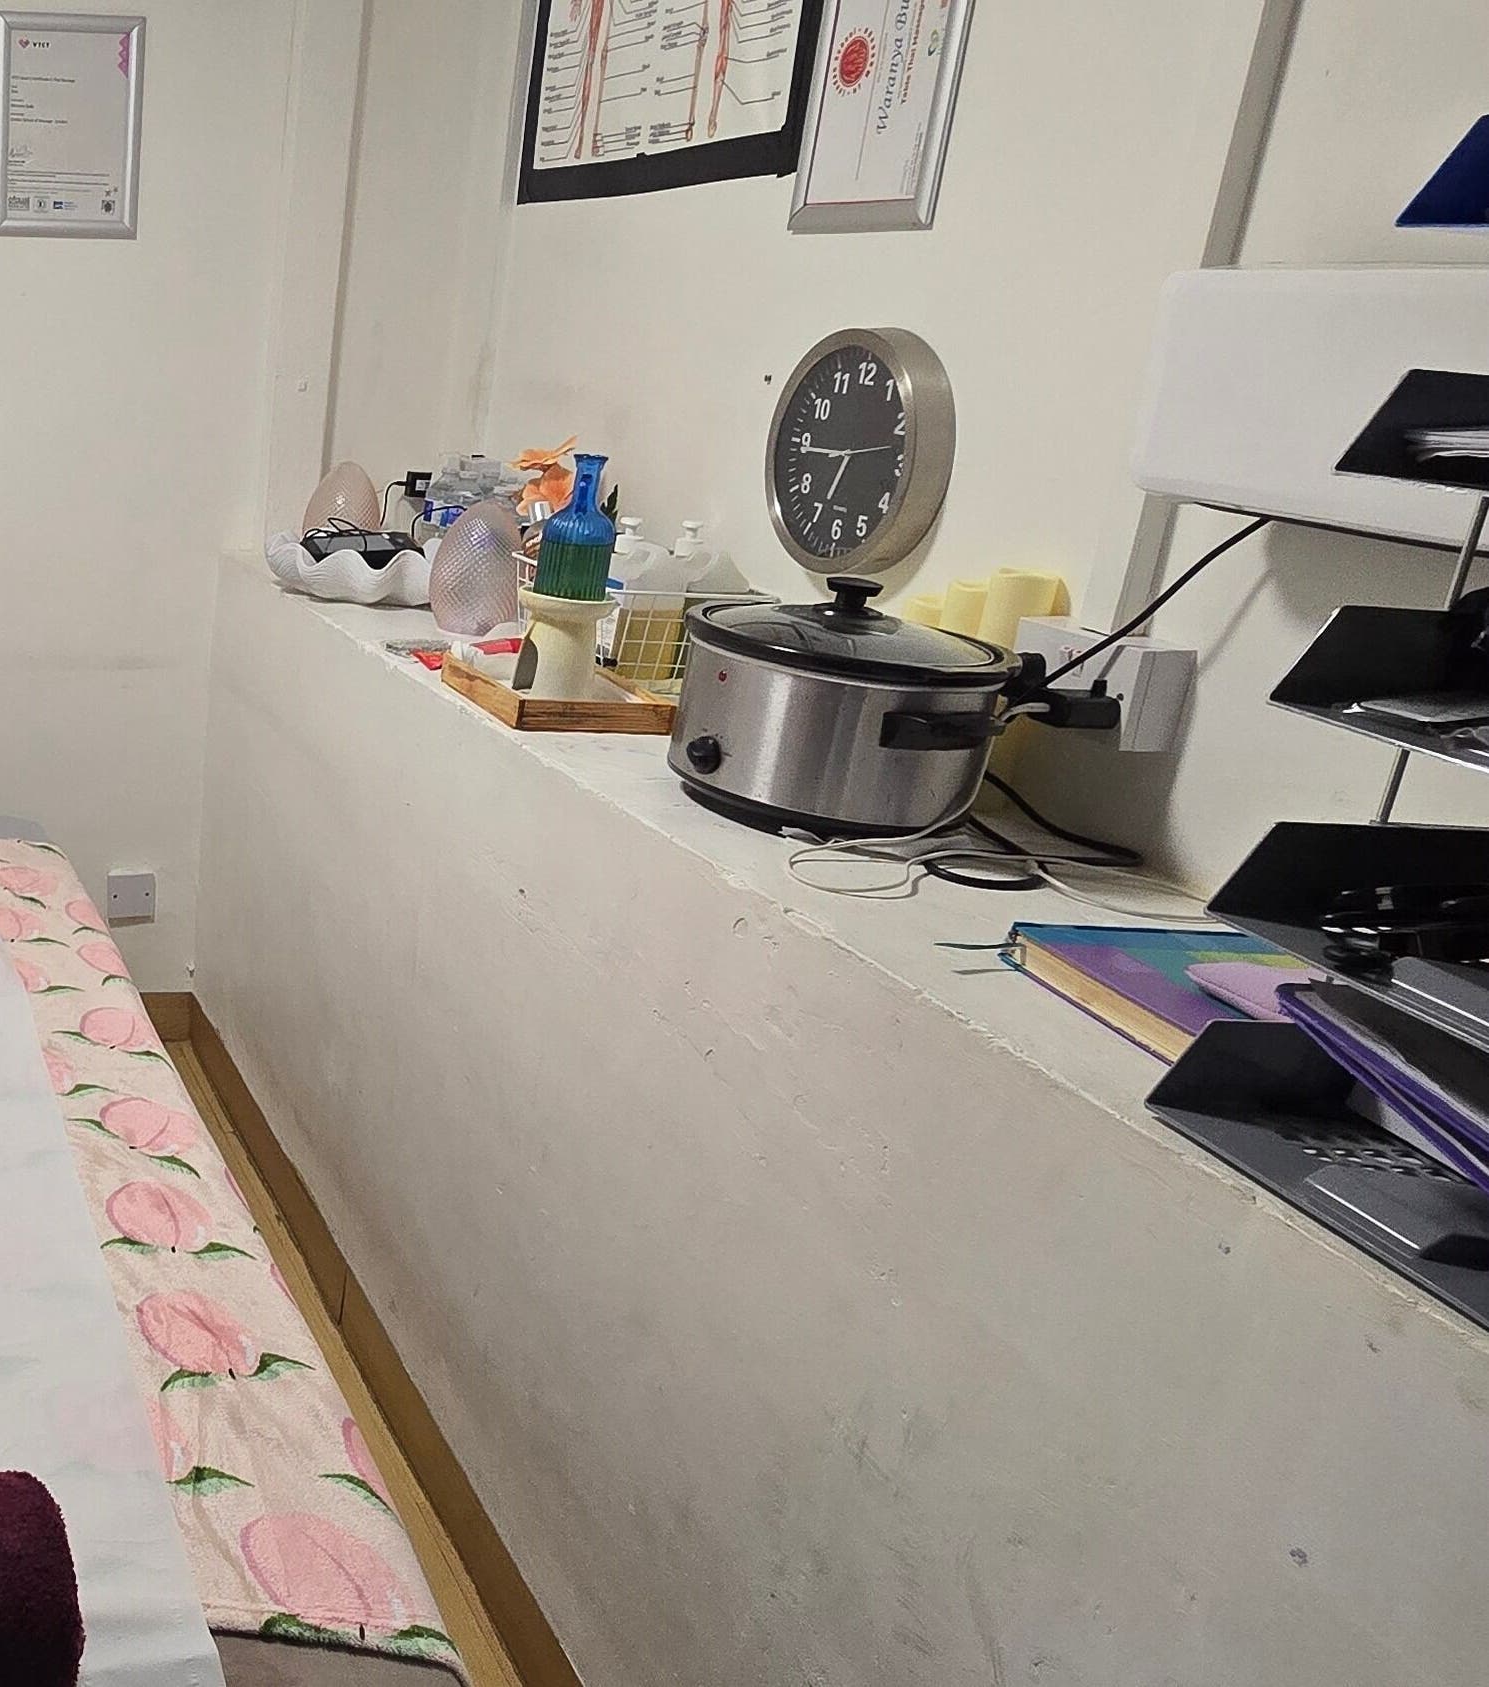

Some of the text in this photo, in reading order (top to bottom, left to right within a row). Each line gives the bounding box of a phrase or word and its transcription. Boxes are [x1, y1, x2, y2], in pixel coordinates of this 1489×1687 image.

[877, 37, 904, 135] Waranya
[834, 371, 850, 394] 11
[858, 361, 877, 386] 12
[885, 378, 895, 401] 1
[814, 397, 831, 421] 10
[893, 411, 906, 436] 2
[800, 432, 812, 454] 9
[800, 472, 812, 494] 8
[813, 502, 823, 524] 7
[877, 491, 892, 514] 4
[831, 518, 843, 540] 6
[856, 515, 868, 537] 5
